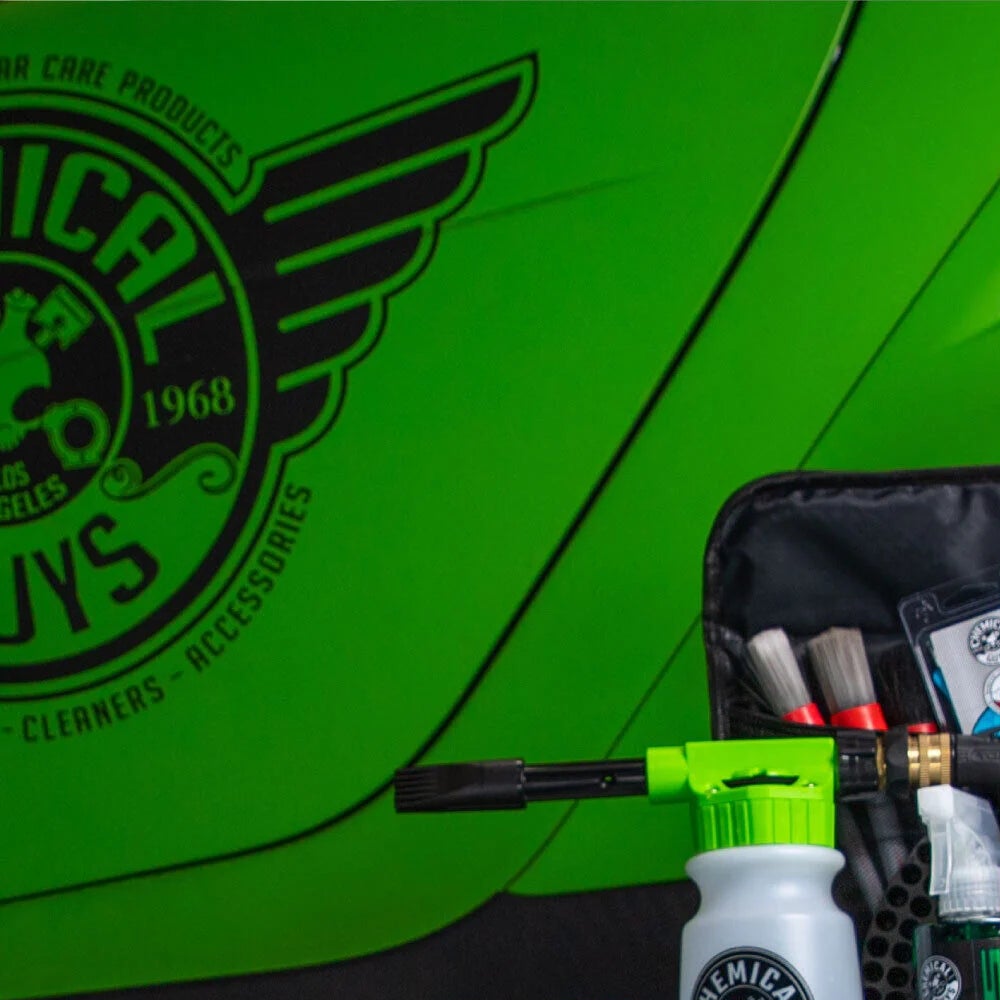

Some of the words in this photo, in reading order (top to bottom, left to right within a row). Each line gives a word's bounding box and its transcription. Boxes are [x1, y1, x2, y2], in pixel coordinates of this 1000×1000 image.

[0, 53, 30, 80] AR
[42, 53, 111, 90] CARE
[118, 69, 243, 170] PRODUCTS
[0, 144, 226, 364] ICAL
[141, 376, 236, 428] 1968
[0, 473, 68, 520] GELES
[0, 513, 160, 645] UYS
[22, 676, 165, 743] CLEANERS
[185, 482, 312, 673] ACCESSORIES
